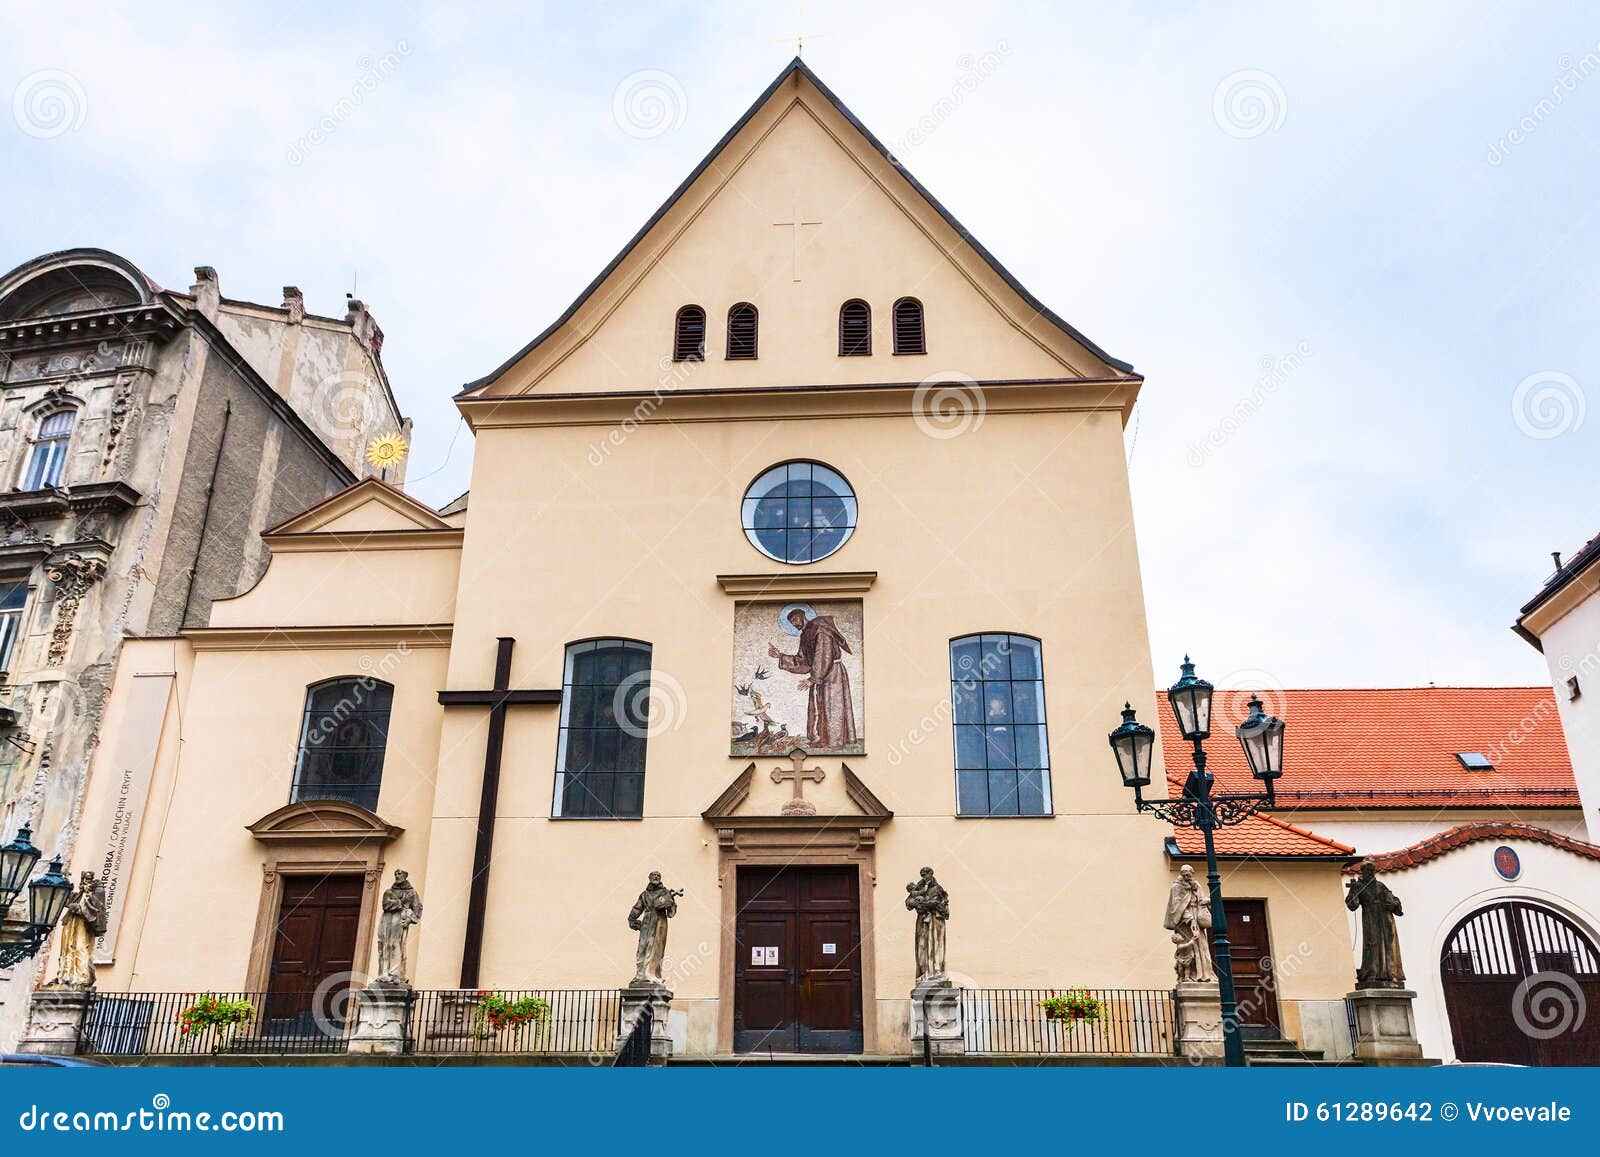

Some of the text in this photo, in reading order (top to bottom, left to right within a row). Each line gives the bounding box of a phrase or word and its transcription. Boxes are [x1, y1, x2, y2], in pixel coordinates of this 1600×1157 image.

[110, 797, 127, 841] CAPUCHIN
[120, 769, 133, 795] CRYPT
[114, 837, 127, 872] MORAVIAN
